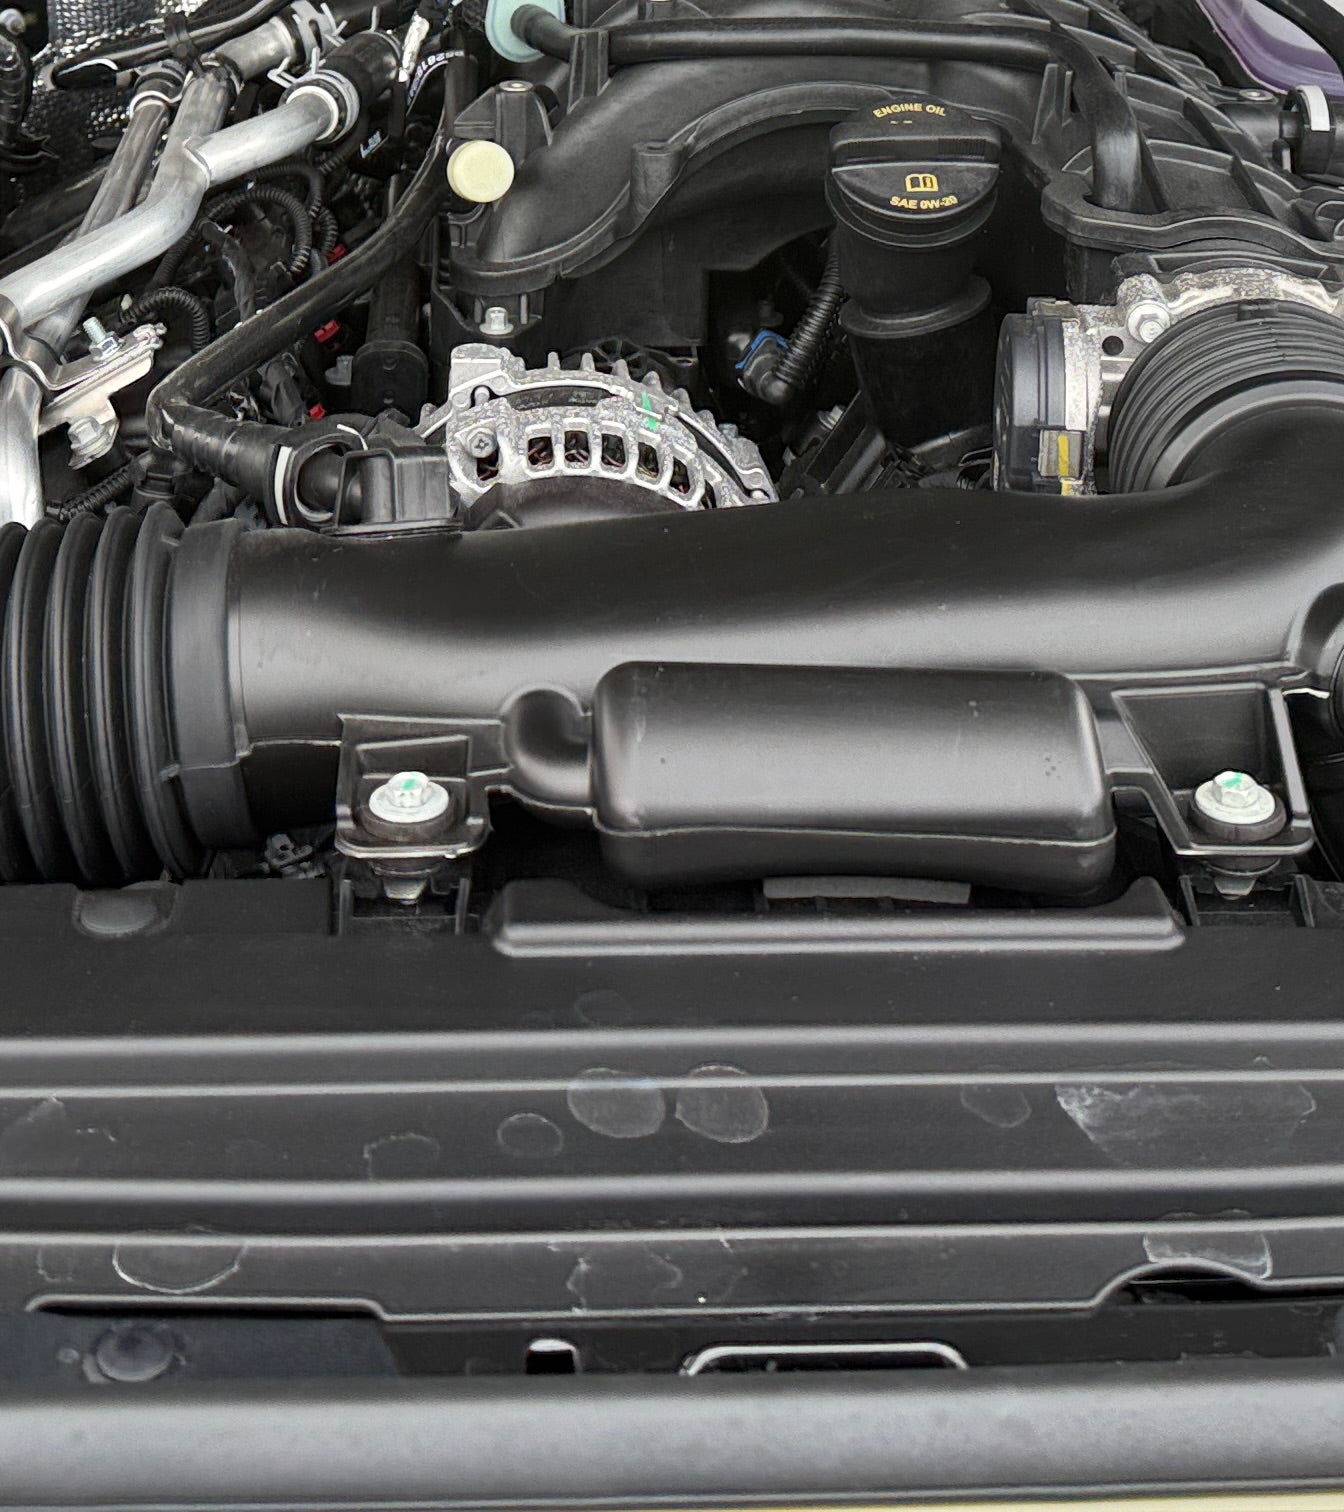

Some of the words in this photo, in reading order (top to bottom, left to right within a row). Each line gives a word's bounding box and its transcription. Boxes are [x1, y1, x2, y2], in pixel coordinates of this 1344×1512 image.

[872, 103, 923, 119] ENGINE
[925, 104, 947, 117] OIL
[889, 195, 918, 209] SAE
[919, 195, 959, 210] 0W-20
